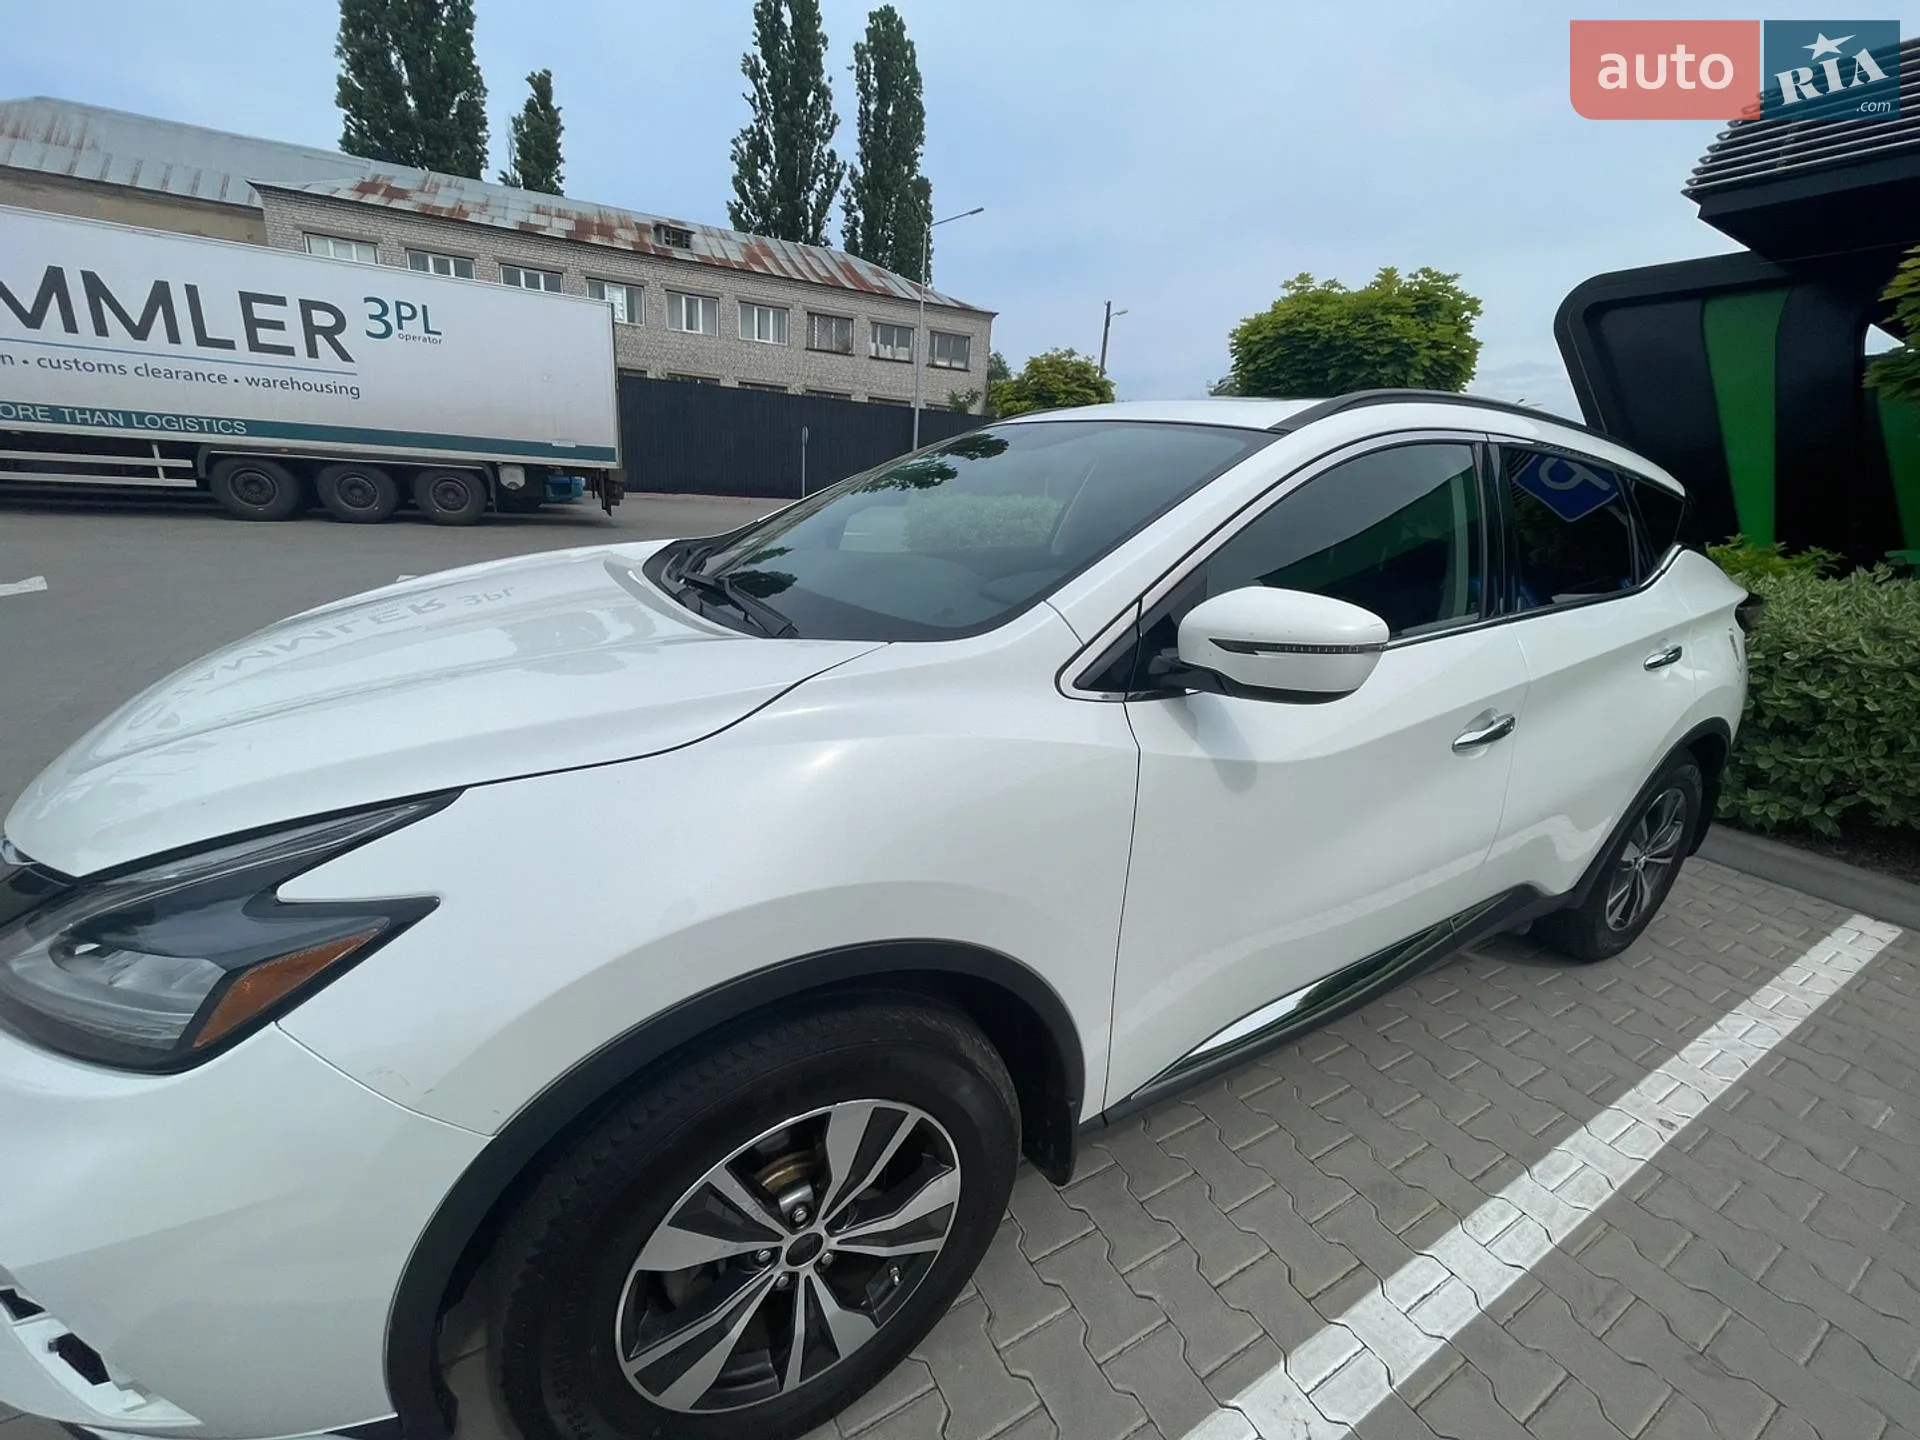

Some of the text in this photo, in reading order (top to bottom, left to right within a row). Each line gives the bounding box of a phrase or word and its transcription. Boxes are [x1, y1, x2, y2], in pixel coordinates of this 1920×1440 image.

[0, 265, 442, 363] MMLER 3PL
[398, 333, 442, 345] operator
[37, 357, 127, 375] customs
[134, 363, 227, 384] clearance
[245, 375, 360, 400] warehousing
[59, 407, 124, 427] THAN
[132, 413, 247, 435] LOGISTICS
